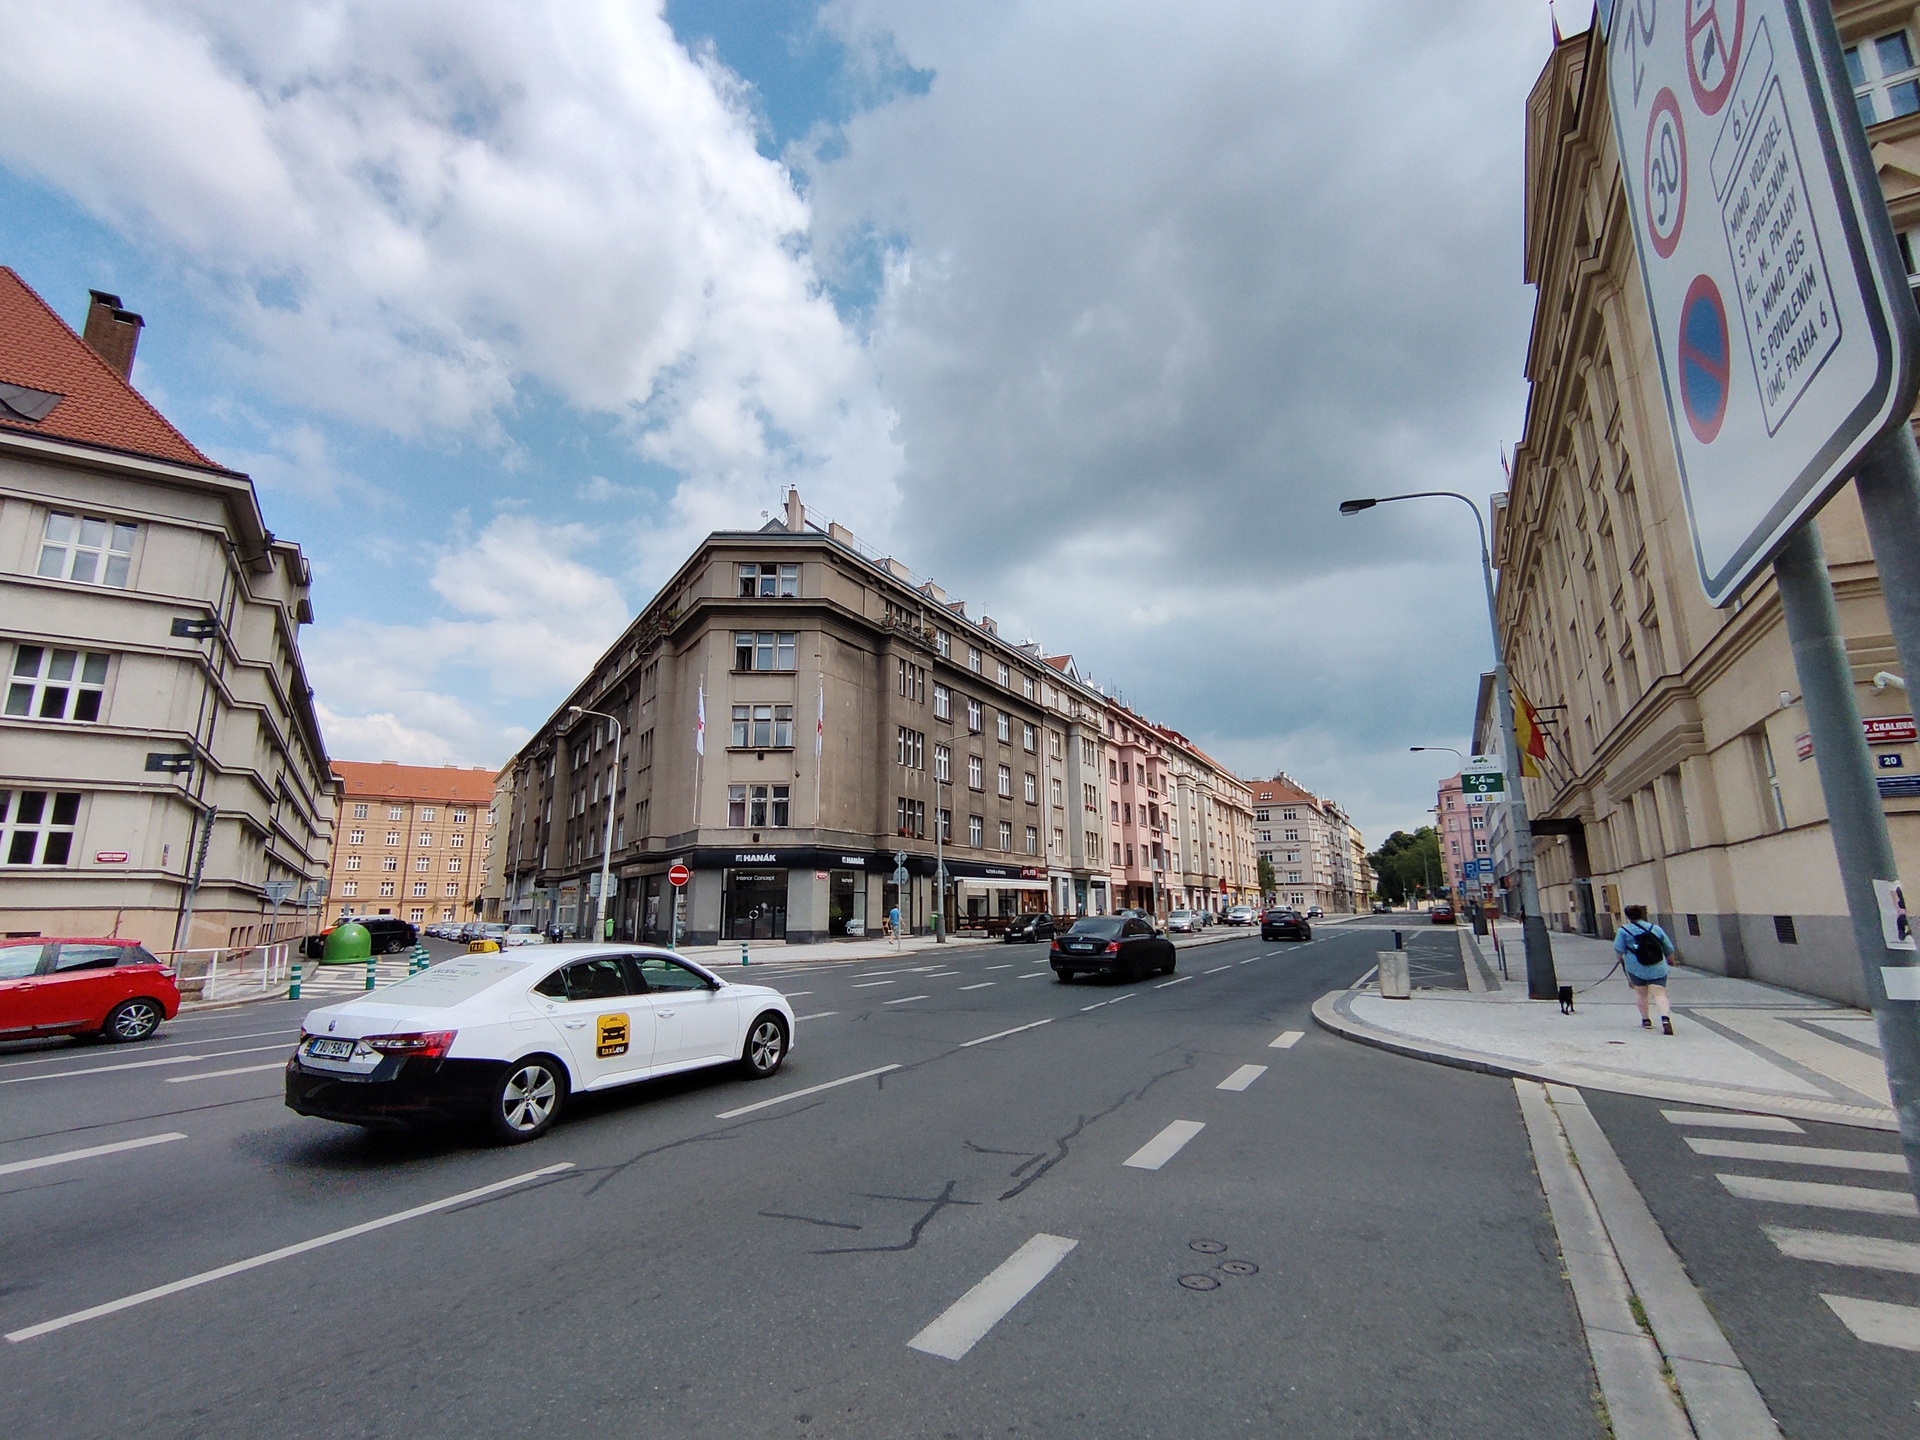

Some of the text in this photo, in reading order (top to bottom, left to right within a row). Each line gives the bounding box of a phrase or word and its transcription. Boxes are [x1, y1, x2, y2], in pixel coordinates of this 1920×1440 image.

[1651, 122, 1678, 226] 30
[1732, 109, 1741, 141] 6
[1730, 115, 1783, 240] MIMO VOZIDEL
[1738, 151, 1790, 268] S POVOLENÍM
[1744, 186, 1798, 304] HL. M. PRAHY
[1755, 229, 1806, 335] A MIMO BUS
[1760, 262, 1817, 371] S POVOLENÍM
[1766, 301, 1828, 408] ÚMČ PRAHA 6
[1469, 775, 1486, 785] 2,4
[1883, 757, 1897, 765] 20
[743, 853, 776, 862] HANÁK
[470, 943, 484, 951] TAXI
[601, 1045, 625, 1055] taxi.eu
